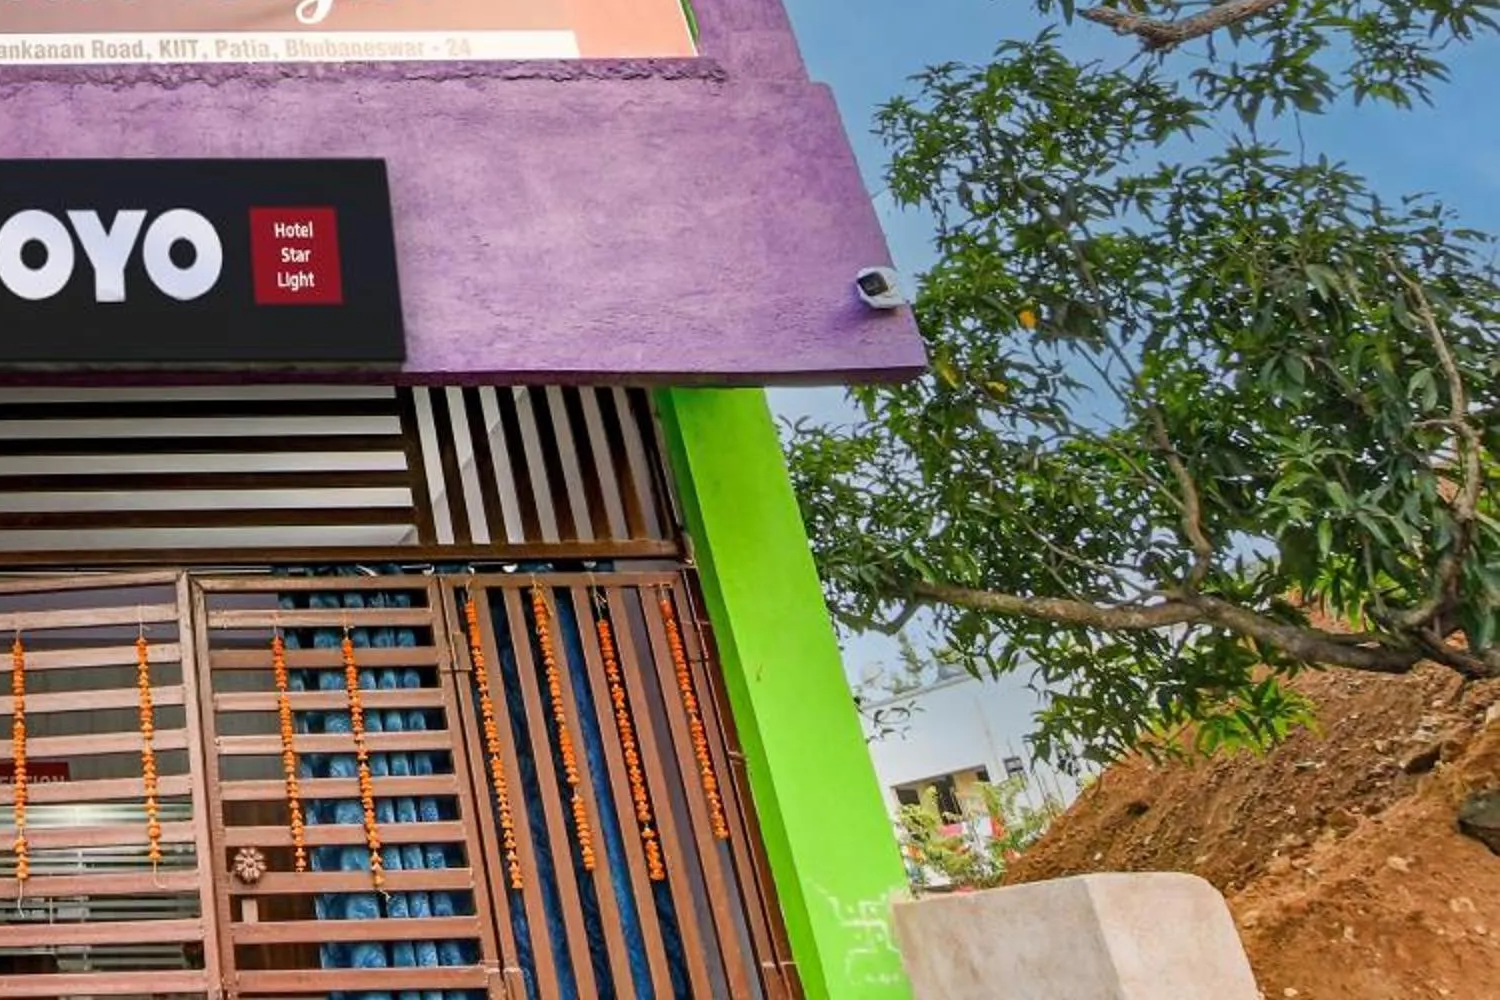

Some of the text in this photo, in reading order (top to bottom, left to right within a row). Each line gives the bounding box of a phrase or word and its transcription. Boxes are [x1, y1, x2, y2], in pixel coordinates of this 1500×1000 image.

[91, 39, 151, 60] Road,
[158, 39, 208, 59] KIIT,
[215, 39, 278, 59] Patia,
[286, 39, 424, 58] Bhubaneswar
[446, 38, 472, 57] 24
[274, 220, 314, 239] Hotel
[281, 247, 311, 263] Star
[277, 271, 315, 292] Light
